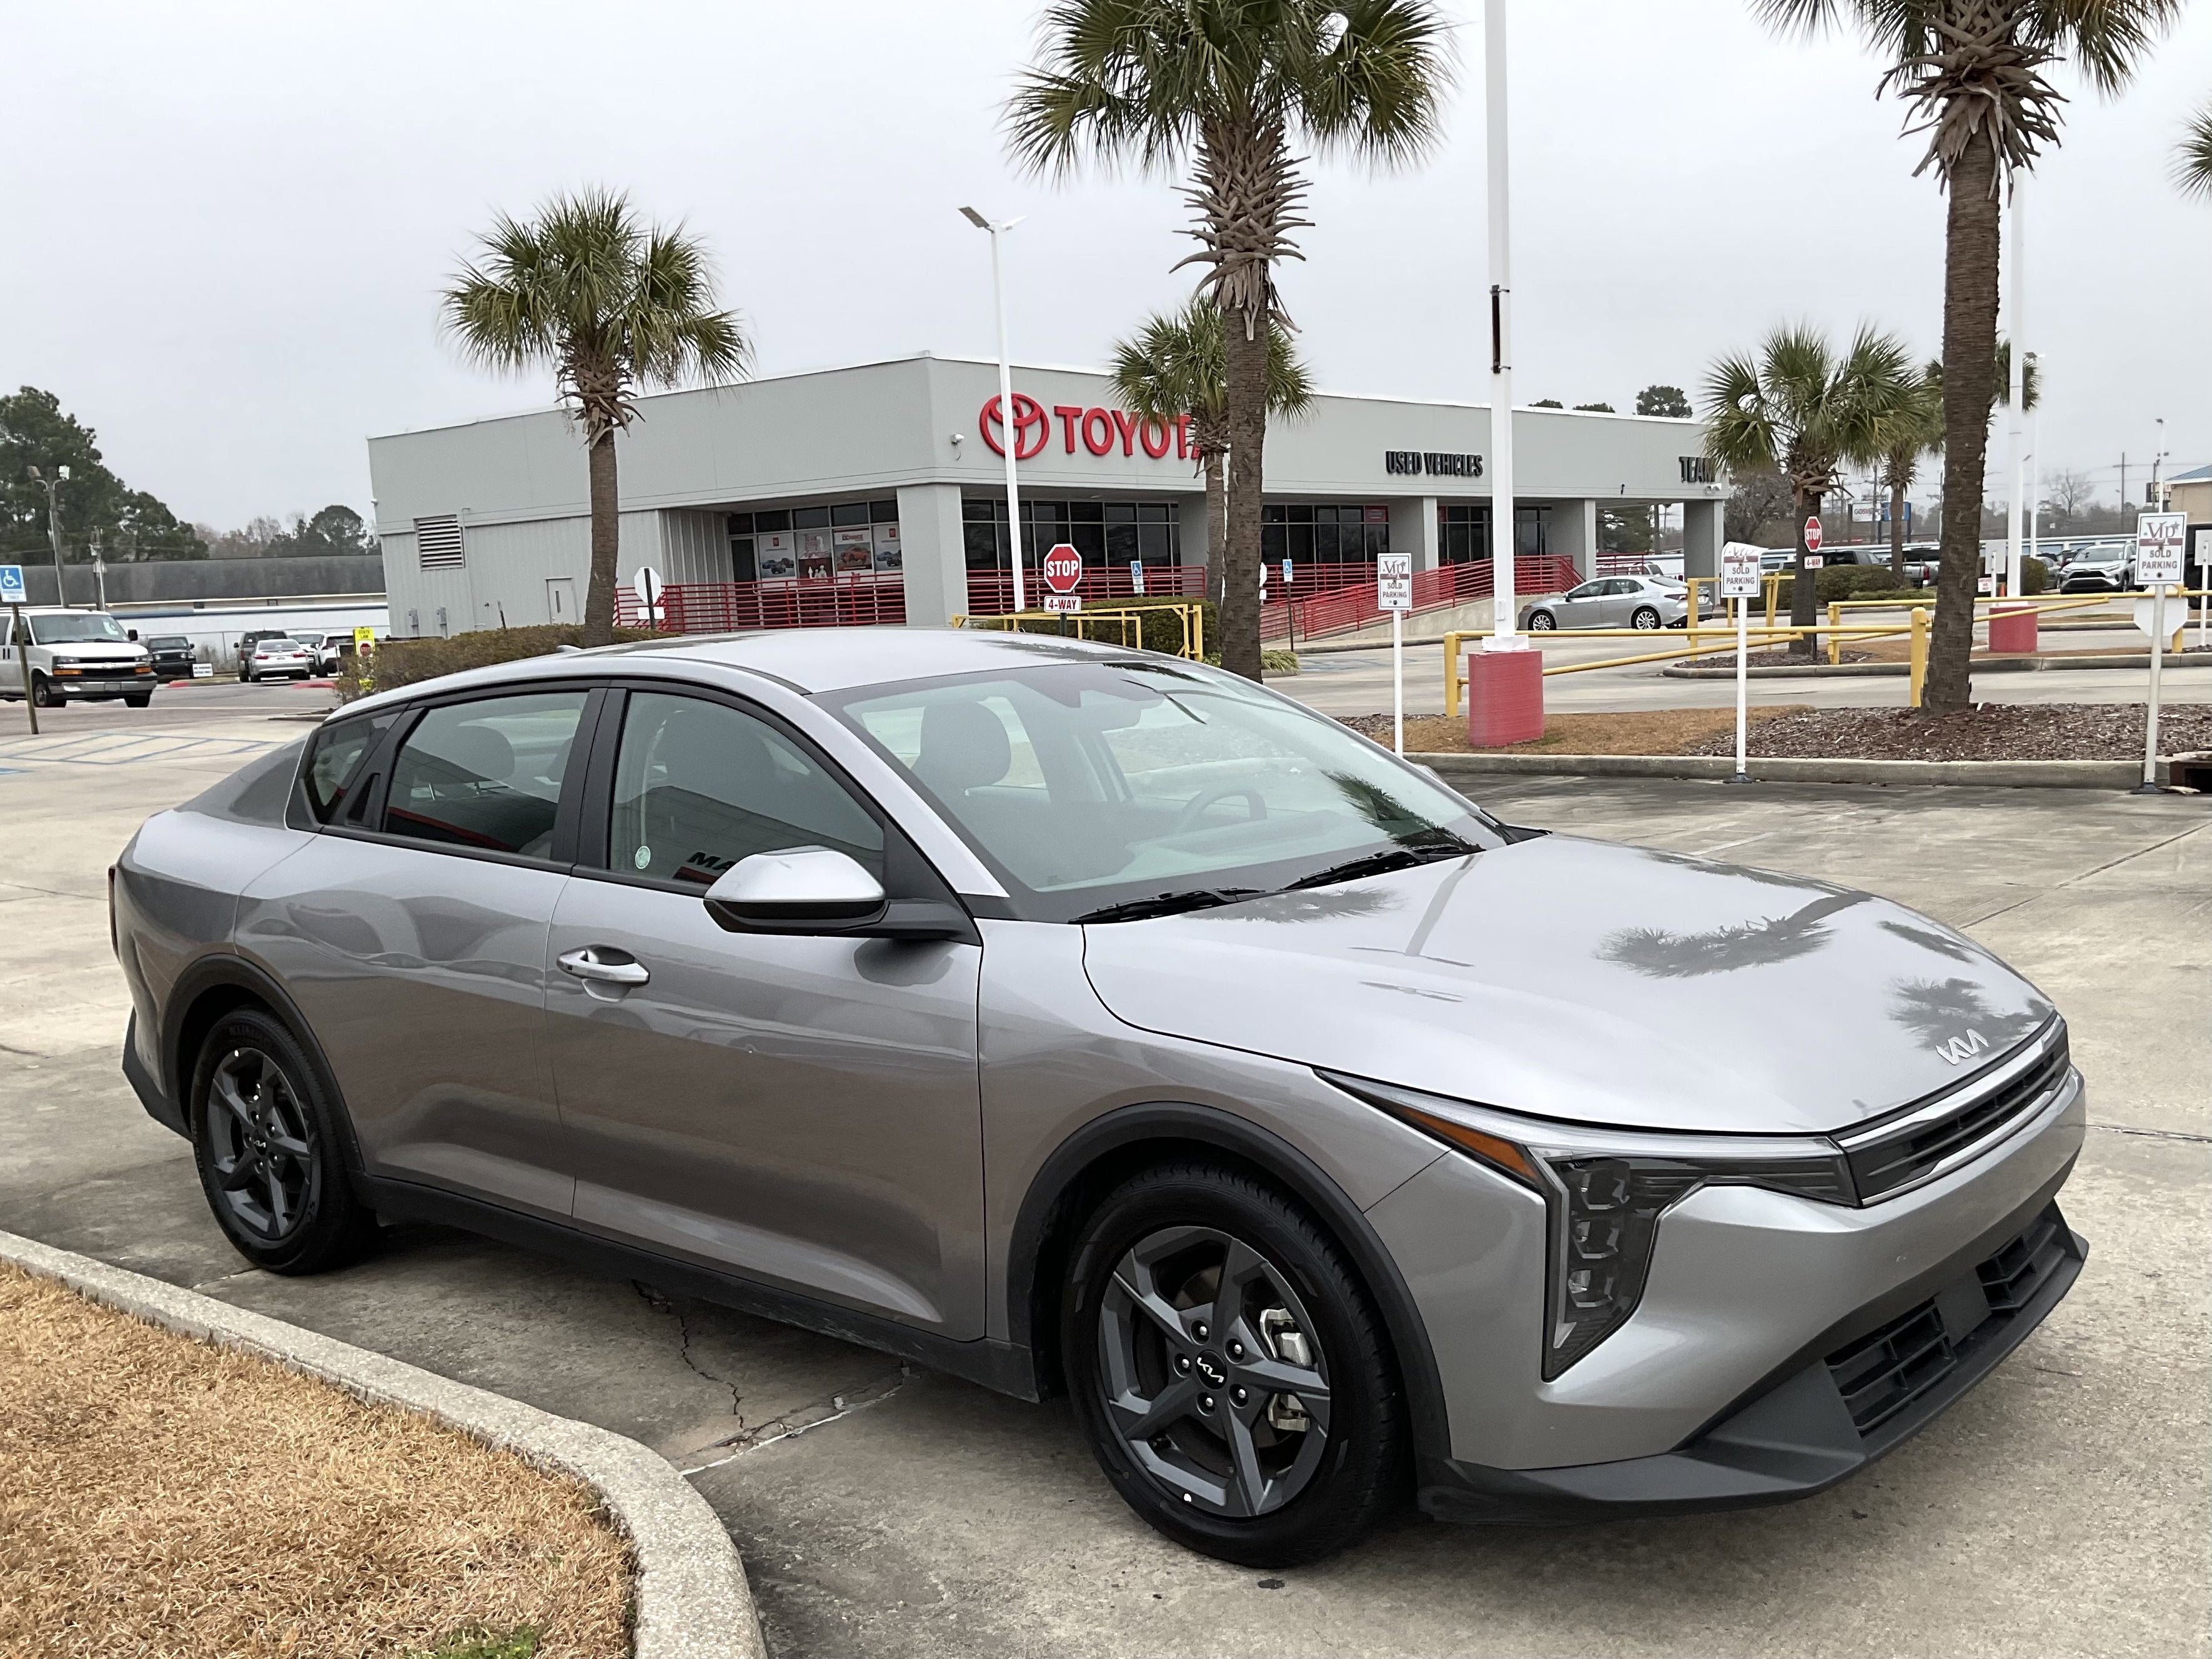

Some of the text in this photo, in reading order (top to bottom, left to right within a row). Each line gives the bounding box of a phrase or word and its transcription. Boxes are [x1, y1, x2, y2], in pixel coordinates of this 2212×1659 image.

[1054, 405, 1201, 459] TOYOT
[1386, 451, 1483, 477] USED VEHICLES
[1806, 528, 1820, 540] STOP
[2149, 550, 2171, 558] SOLD
[1047, 560, 1079, 577] STOP
[2141, 561, 2178, 569] PARKING
[1726, 577, 1755, 585] PARKING
[1048, 599, 1077, 610] 4-WAY
